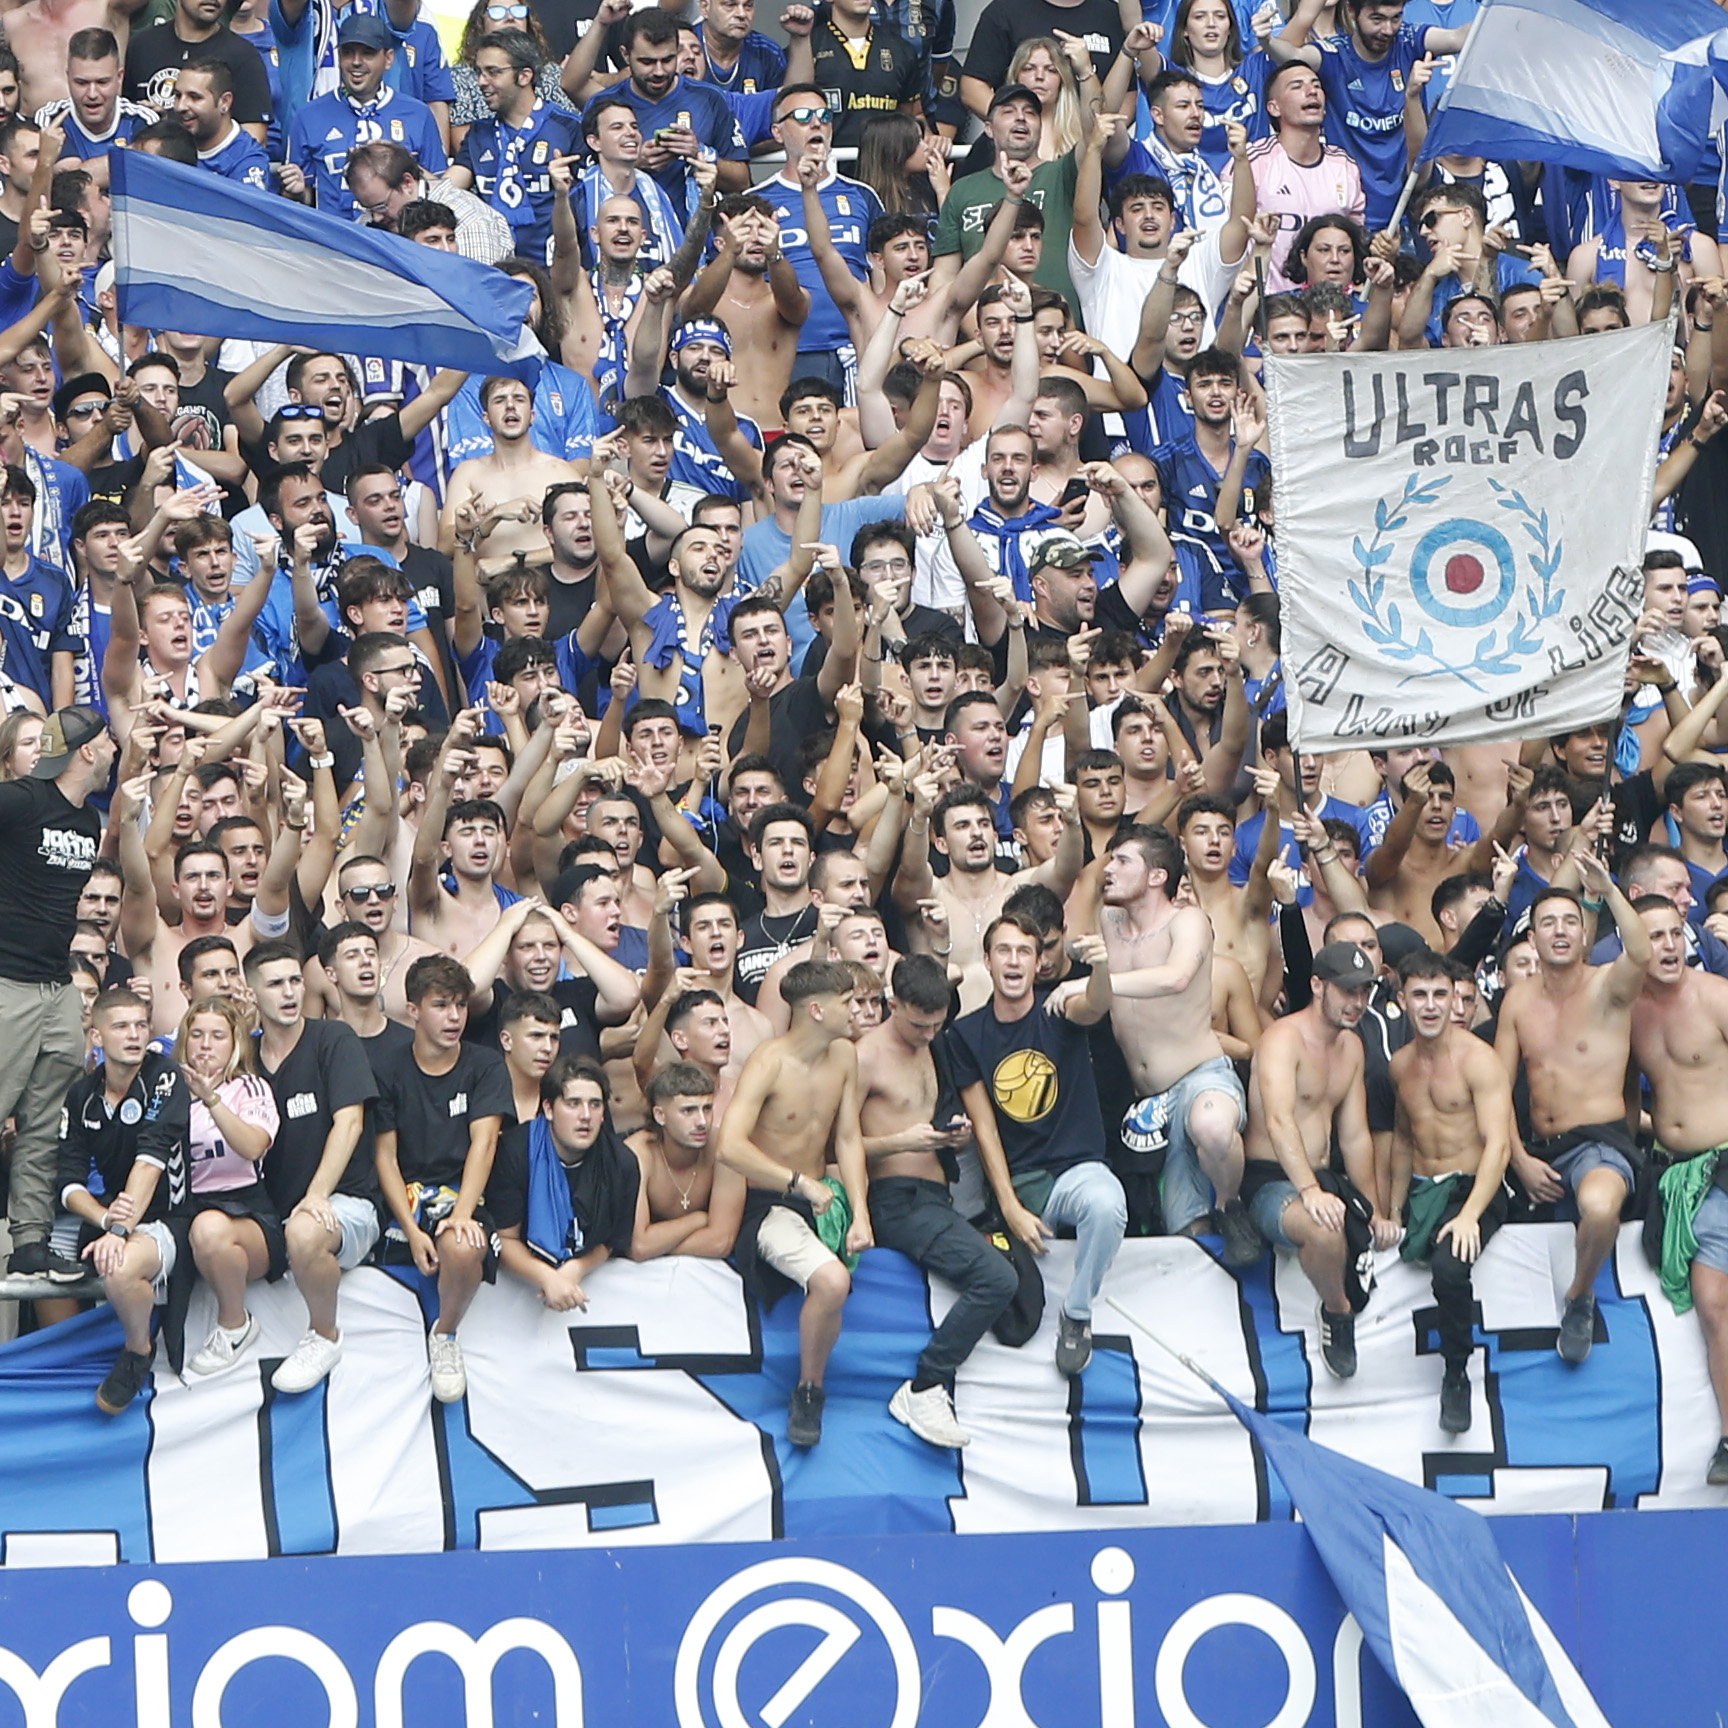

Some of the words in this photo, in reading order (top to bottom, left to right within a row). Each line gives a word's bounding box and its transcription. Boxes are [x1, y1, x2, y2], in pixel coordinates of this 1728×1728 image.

[846, 92, 898, 111] Asturia
[1360, 112, 1405, 132] OVIED
[475, 174, 555, 195] DGI
[777, 223, 861, 248] DGI
[1343, 368, 1591, 461] ULTRAS
[1413, 439, 1519, 467] ROCF
[1296, 641, 1351, 707] A
[675, 1546, 1368, 1728] exio
